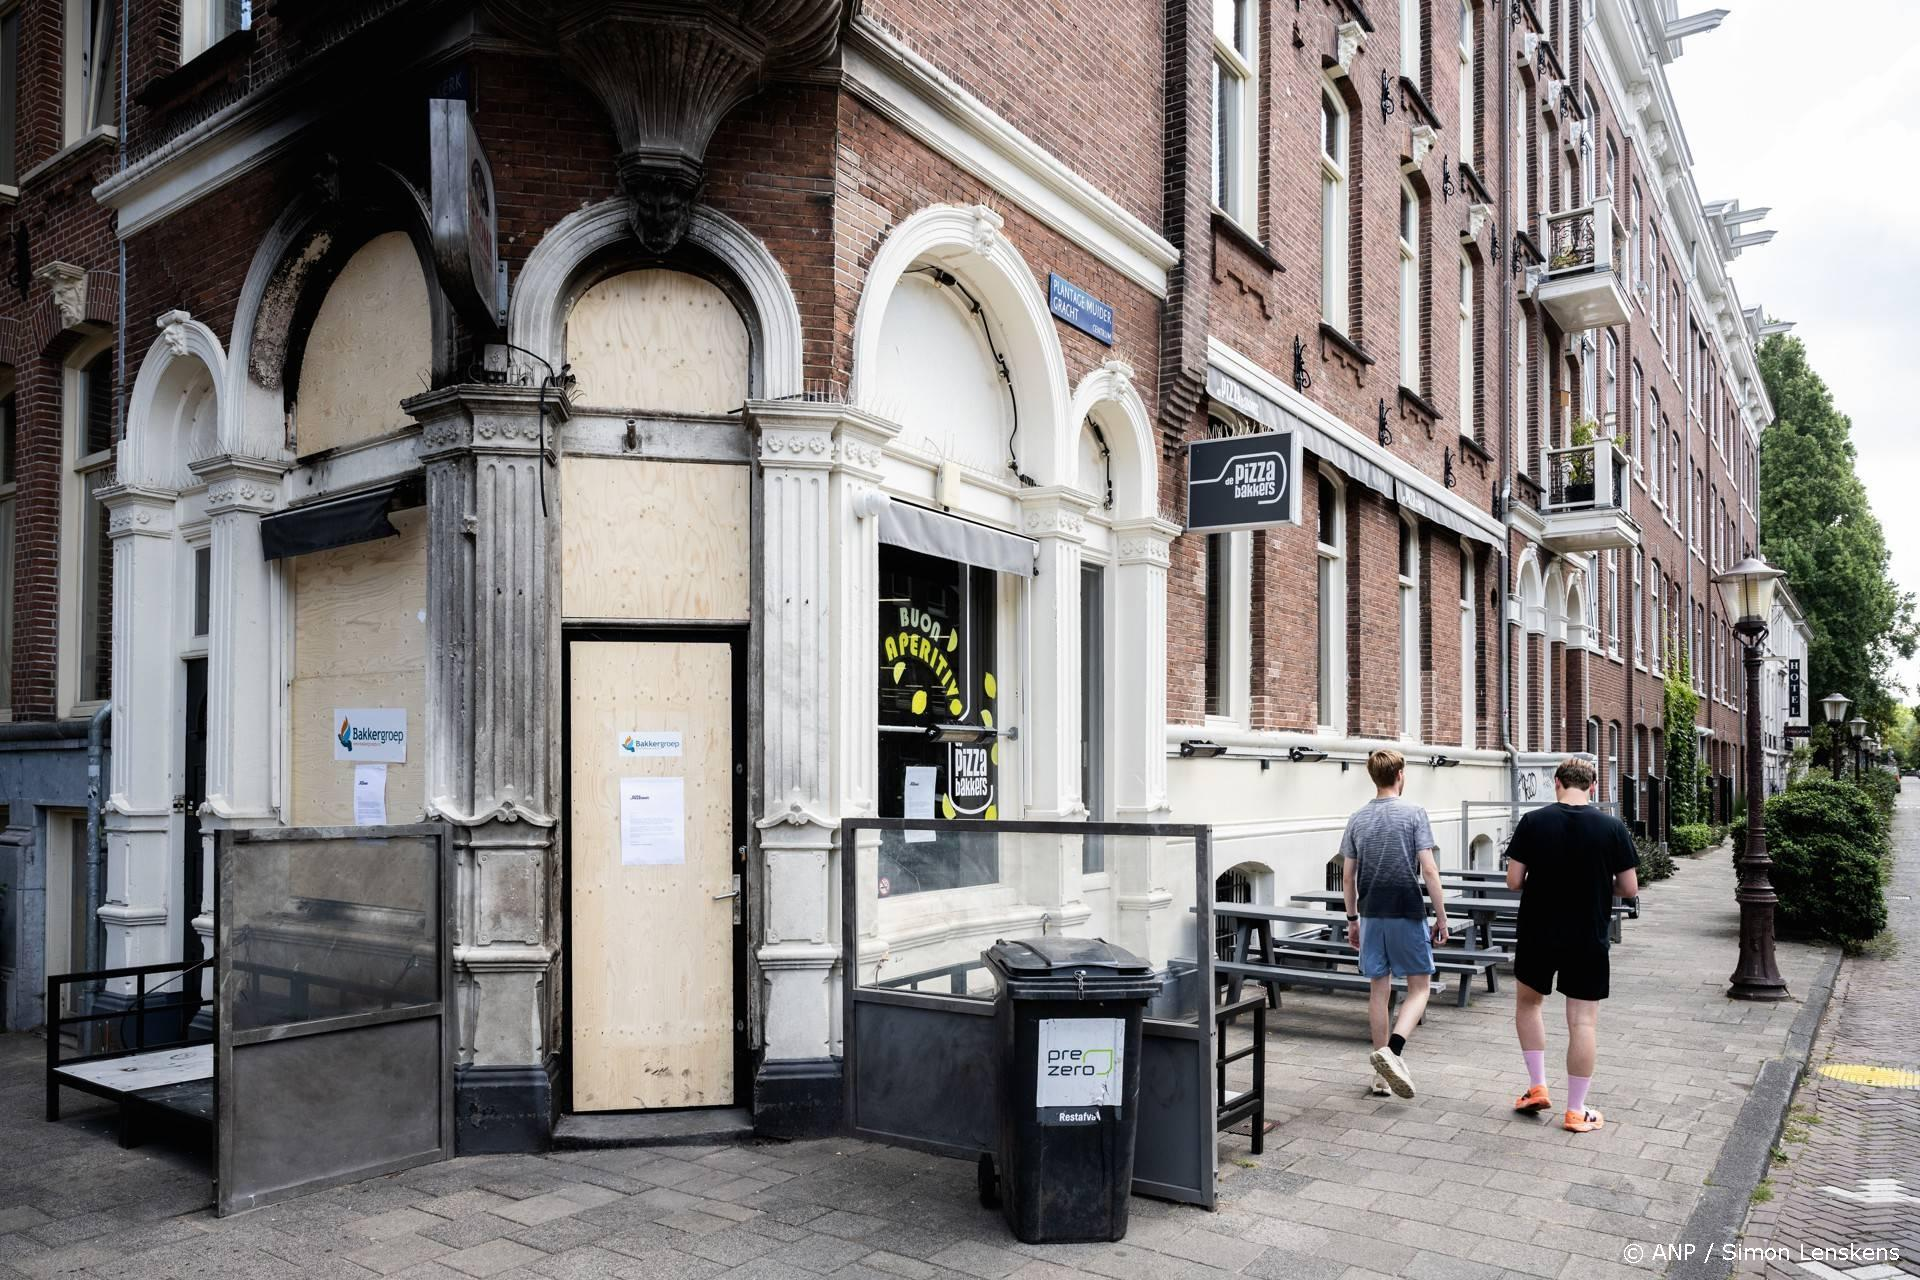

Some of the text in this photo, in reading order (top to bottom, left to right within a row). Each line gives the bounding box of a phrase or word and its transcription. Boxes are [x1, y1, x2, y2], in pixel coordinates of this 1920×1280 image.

[1053, 279, 1112, 325] PLANTAGE MUIDER
[1053, 296, 1079, 321] GRACHT
[1092, 323, 1112, 340] CENTRUM
[1225, 460, 1276, 486] de pizza
[1234, 481, 1276, 499] bakkers
[900, 606, 941, 642] BUON
[1790, 661, 1799, 715] HOTEL
[352, 727, 404, 745] Bakkergroep
[635, 740, 680, 749] Bakkergroep
[955, 748, 987, 777] pizza
[955, 777, 987, 797] bakkers
[1048, 1049, 1082, 1064] pre
[1047, 1065, 1095, 1076] zero
